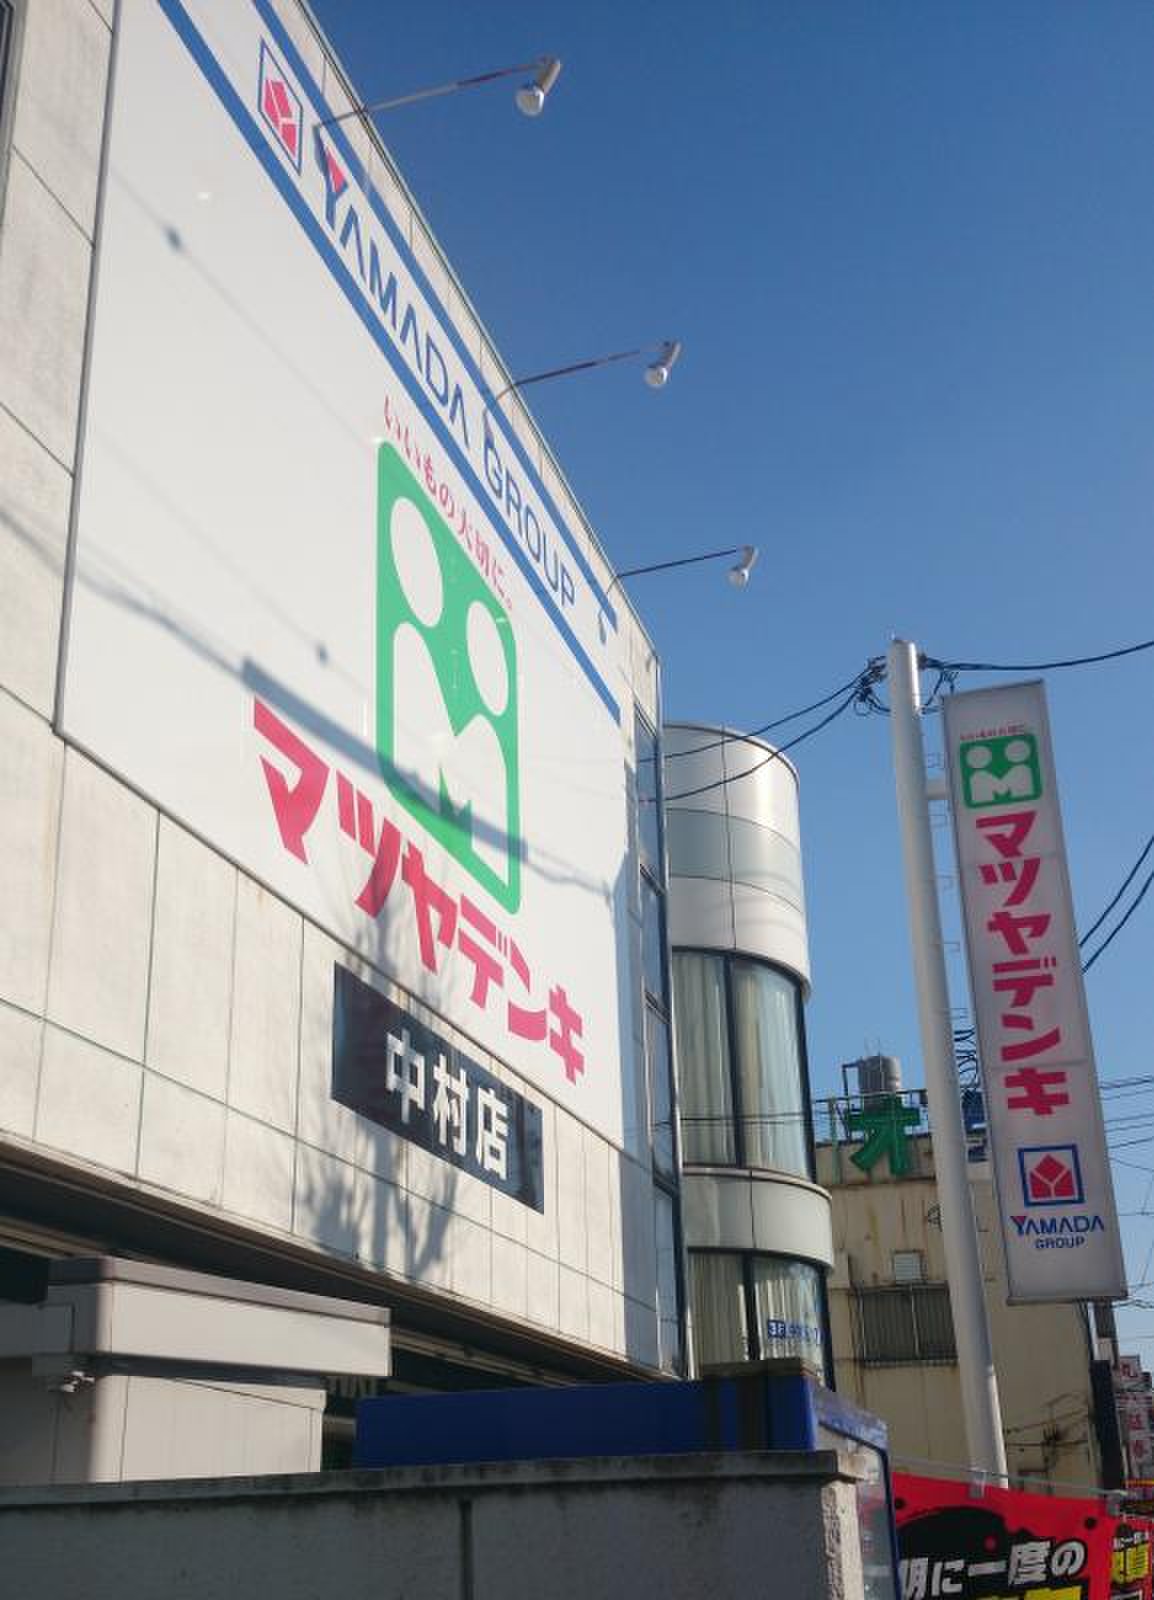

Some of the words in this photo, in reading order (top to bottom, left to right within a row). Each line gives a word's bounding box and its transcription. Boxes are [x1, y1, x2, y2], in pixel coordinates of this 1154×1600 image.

[314, 125, 470, 449] YAMADA
[484, 430, 575, 607] GROUP
[253, 694, 585, 1086] マツヤデンキ
[975, 810, 1070, 1116] マツヤデンキ
[385, 1027, 509, 1181] 中村店
[1010, 1215, 1105, 1236] YAMADA
[1034, 1235, 1085, 1250] GROUP
